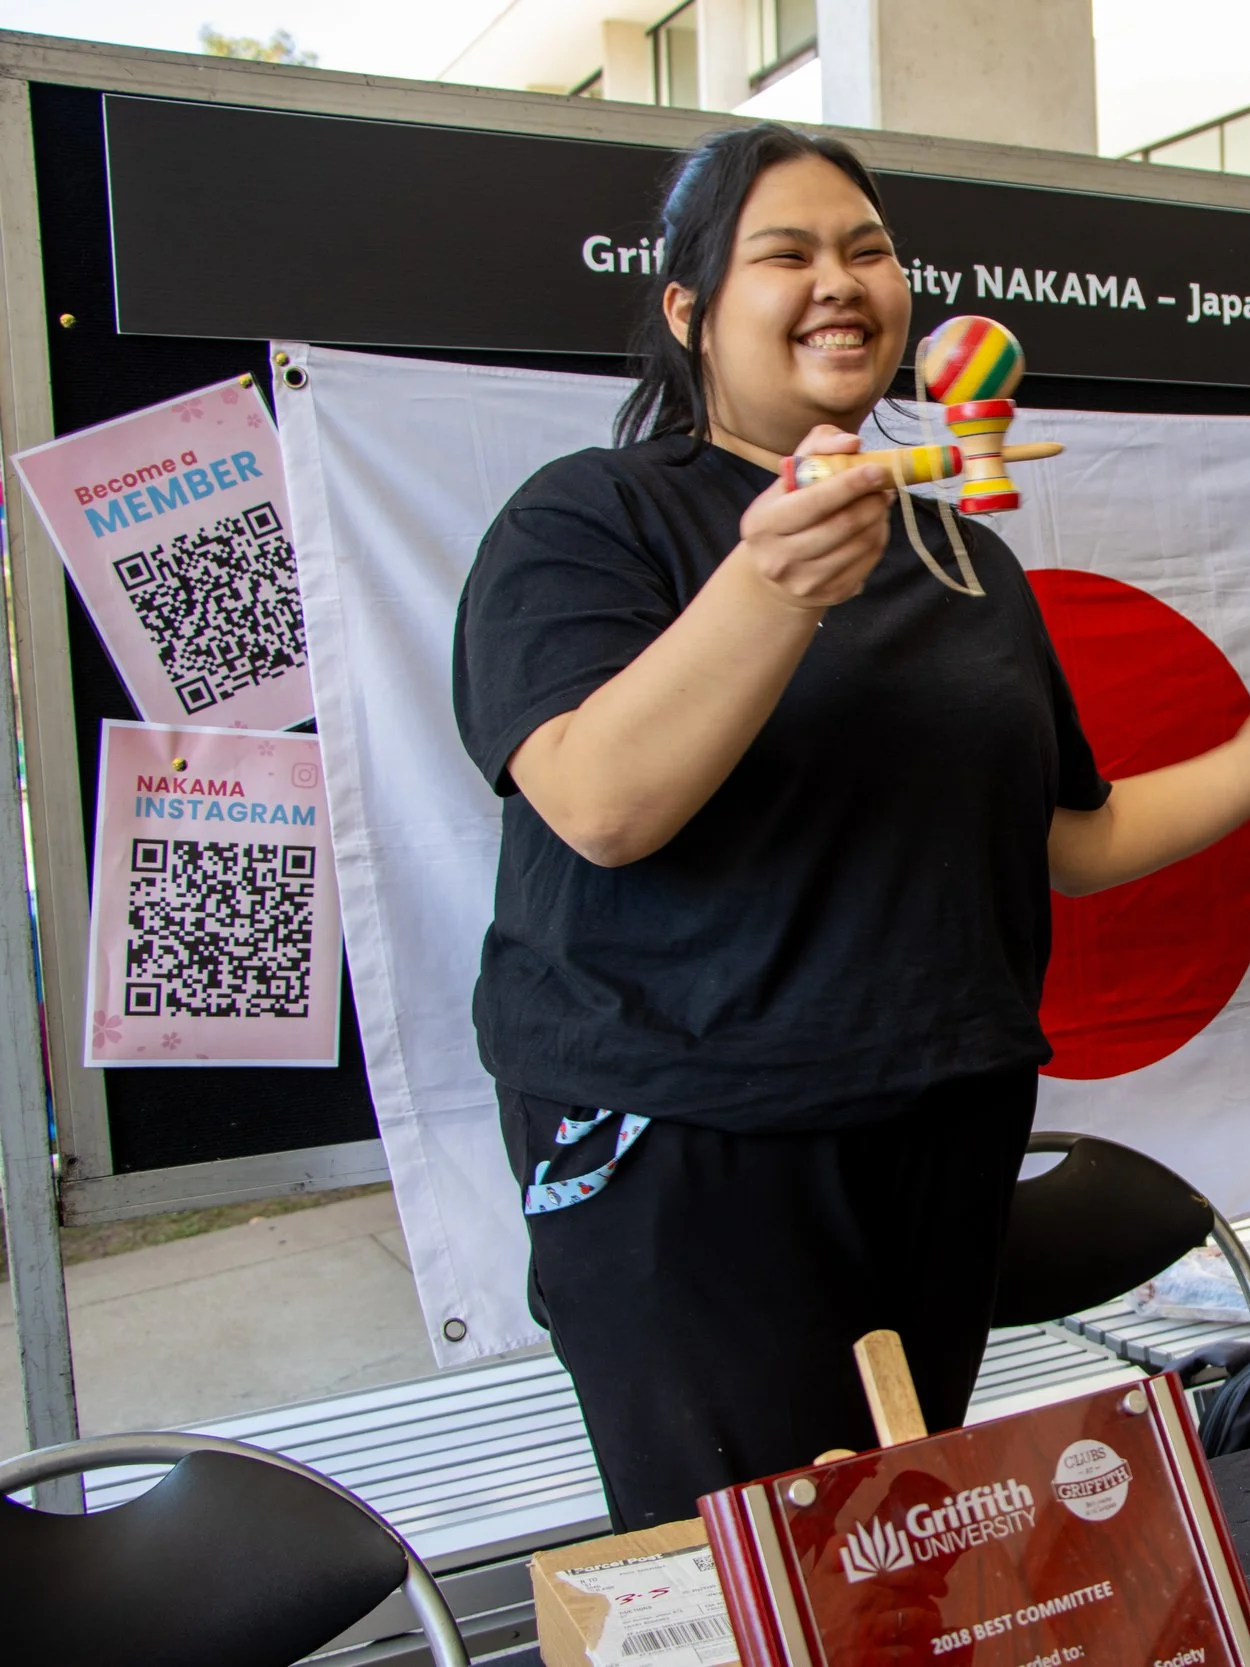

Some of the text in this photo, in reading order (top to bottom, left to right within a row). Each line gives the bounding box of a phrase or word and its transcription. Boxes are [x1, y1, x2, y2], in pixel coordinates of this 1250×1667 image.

[582, 234, 666, 275] Grif
[974, 264, 1147, 311] NAKAMA
[74, 450, 198, 506] Become a
[84, 450, 264, 538] MEMBER
[136, 775, 246, 798] NAKAMA
[134, 796, 317, 827] INSTAGRAM
[1064, 1446, 1107, 1469] CLUBS
[1057, 1465, 1131, 1499] GRIFFITH
[906, 1478, 1034, 1539] Griffith
[913, 1506, 1036, 1561] UNIVERSITY
[573, 1560, 624, 1576] Parcel
[627, 1553, 665, 1566] Post
[930, 1580, 1115, 1656] 2018 BEST COMMITTEE
[1061, 1645, 1085, 1662] to:
